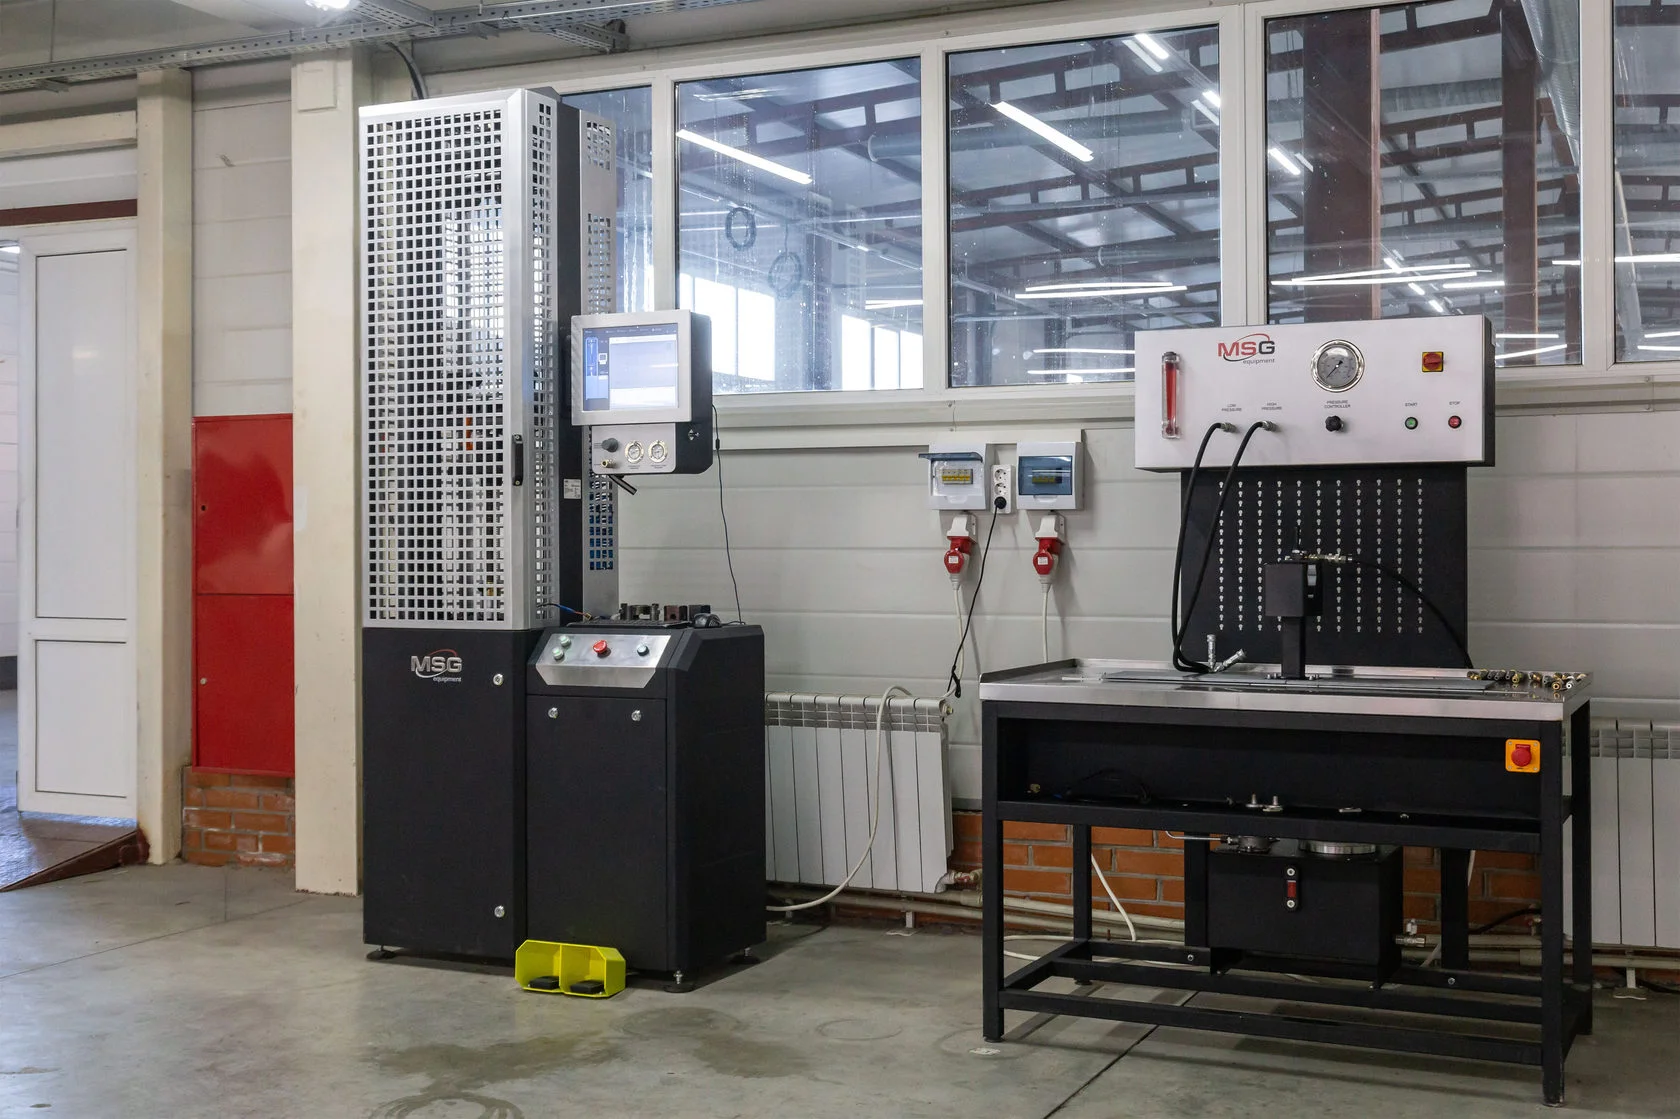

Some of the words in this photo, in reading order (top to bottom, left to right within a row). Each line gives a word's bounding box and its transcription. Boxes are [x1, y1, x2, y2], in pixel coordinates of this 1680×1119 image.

[1217, 340, 1276, 357] MSG
[1242, 358, 1275, 366] equipment
[411, 655, 462, 672] MSG
